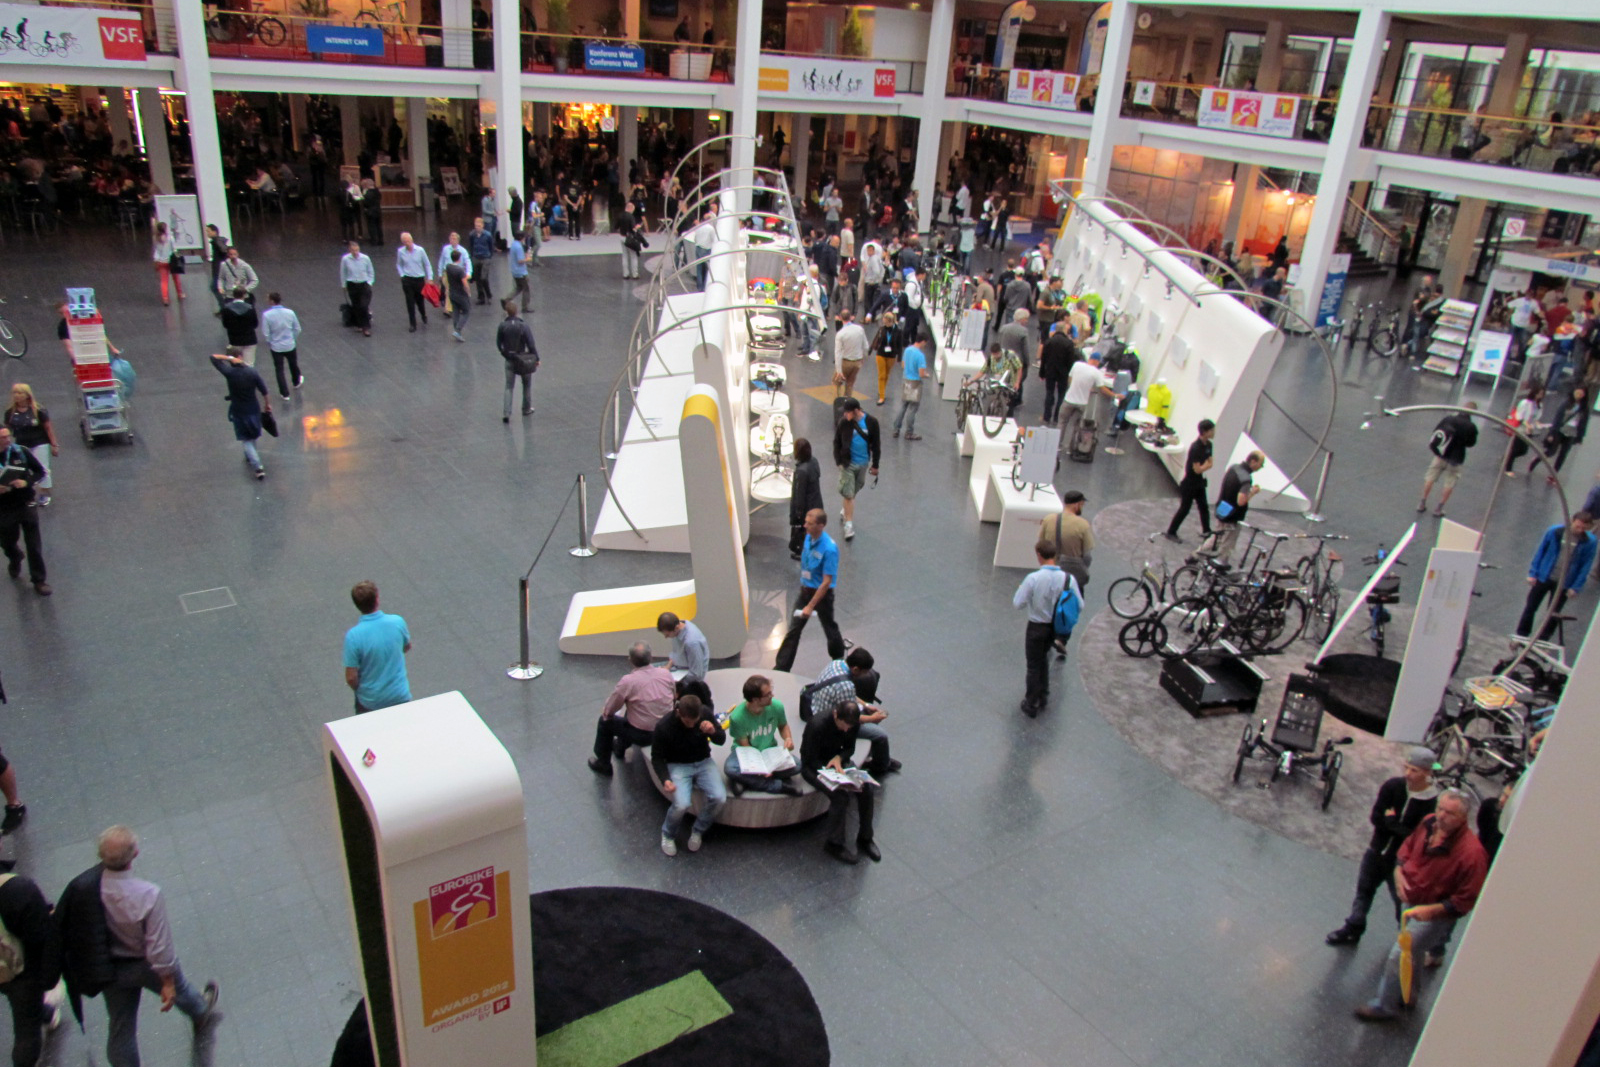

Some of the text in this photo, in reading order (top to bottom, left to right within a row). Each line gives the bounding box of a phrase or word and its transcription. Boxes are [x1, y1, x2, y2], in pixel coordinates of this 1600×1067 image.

[101, 25, 144, 43] VSF.
[325, 37, 352, 45] INTERNET
[589, 49, 633, 59] Konferenz West
[589, 58, 637, 68] Conference West
[875, 74, 895, 87] VSF.
[431, 867, 494, 897] EUROBIKE
[432, 981, 509, 1018] AWARD 2012
[431, 1003, 491, 1034] ORGANIZED
[478, 1011, 491, 1022] BY
